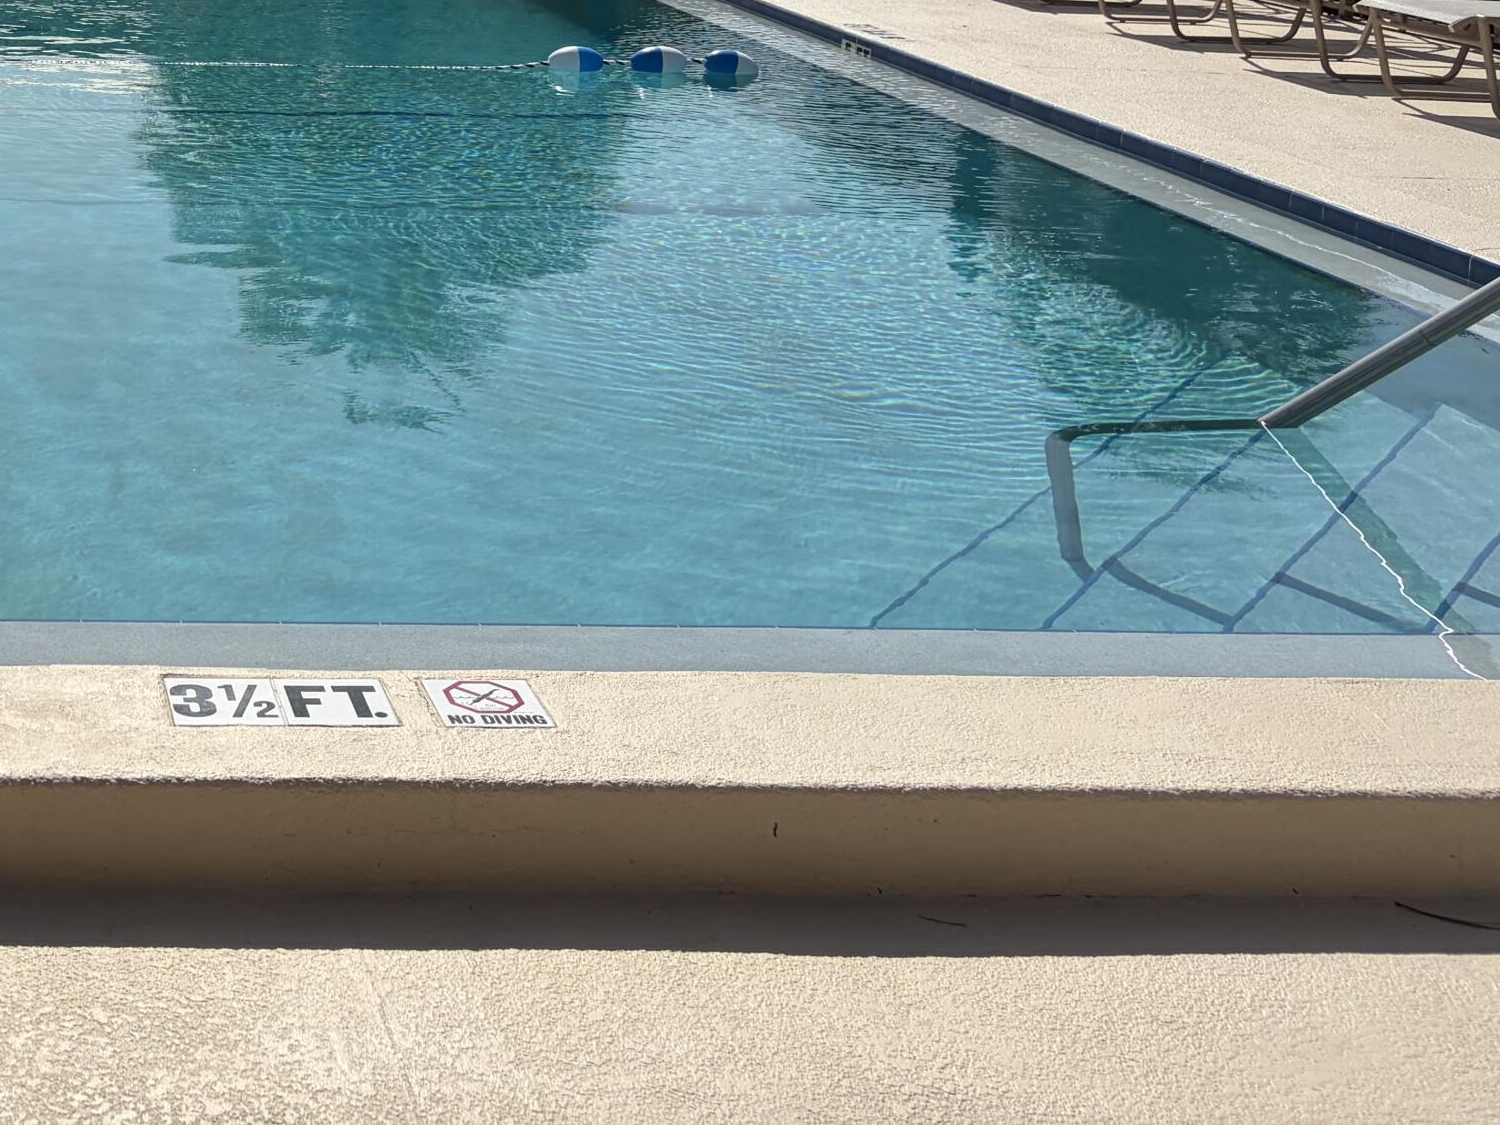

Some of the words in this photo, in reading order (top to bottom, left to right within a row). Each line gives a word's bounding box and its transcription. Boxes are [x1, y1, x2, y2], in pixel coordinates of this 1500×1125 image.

[284, 685, 388, 718] FT.
[447, 714, 476, 725] NO
[480, 714, 549, 725] DIVING
